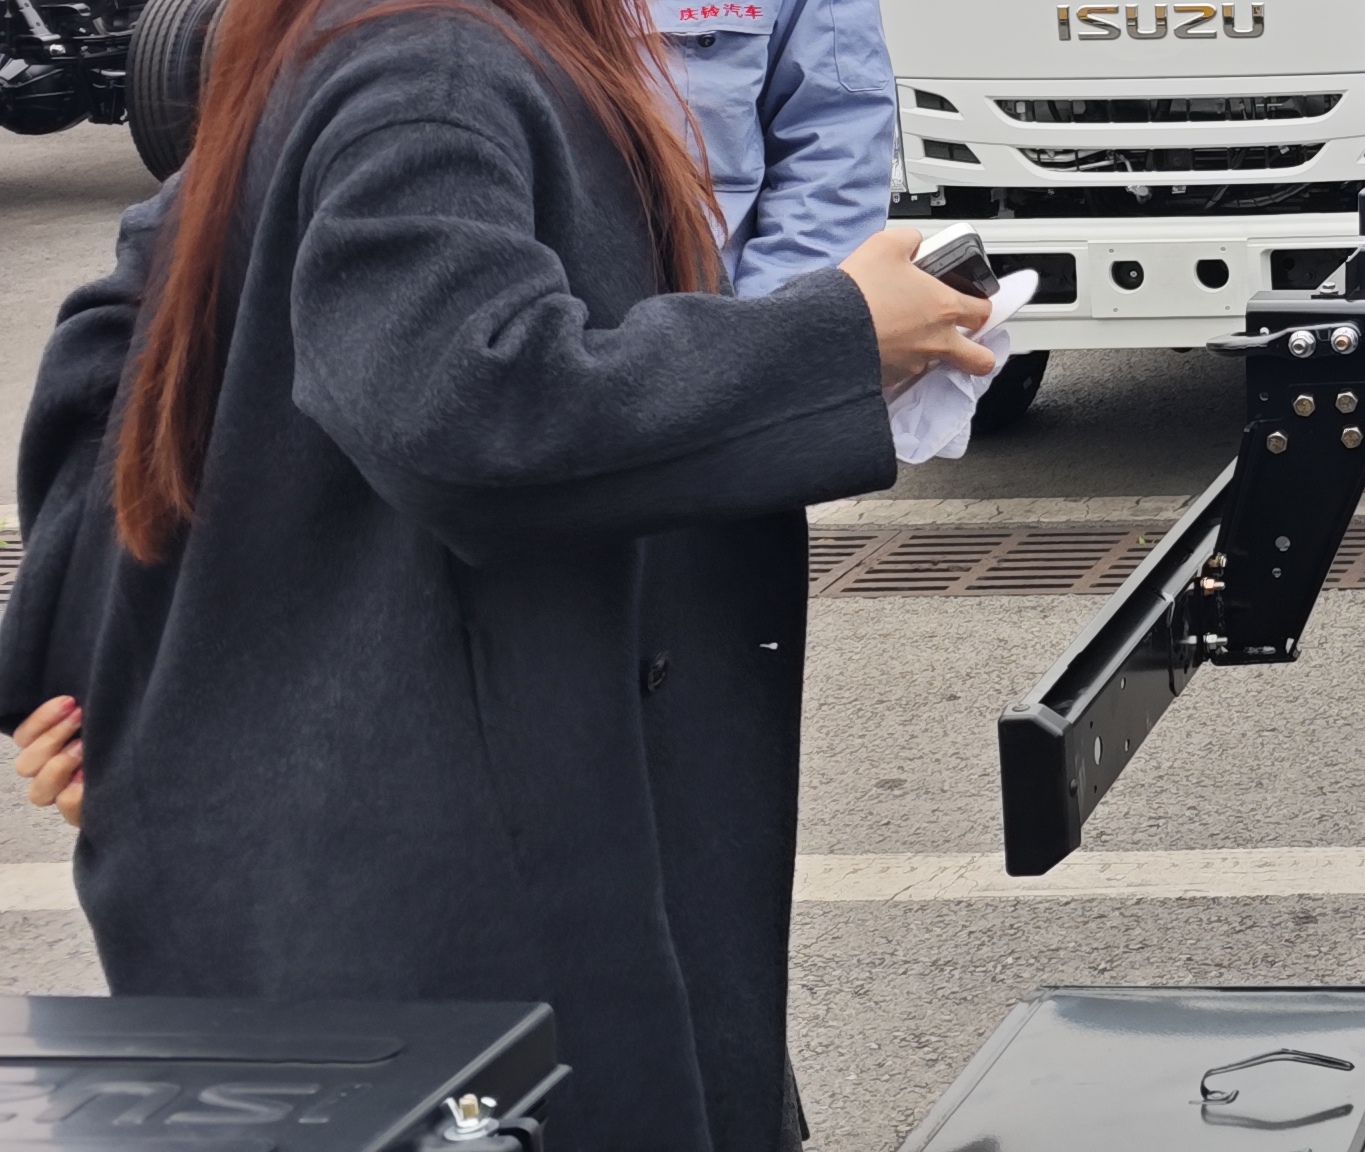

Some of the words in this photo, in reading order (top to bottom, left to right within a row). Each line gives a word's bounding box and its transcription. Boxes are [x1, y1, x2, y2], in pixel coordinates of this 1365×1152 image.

[679, 3, 764, 21] 庆铃汽车
[1056, 2, 1265, 41] ISUZU
